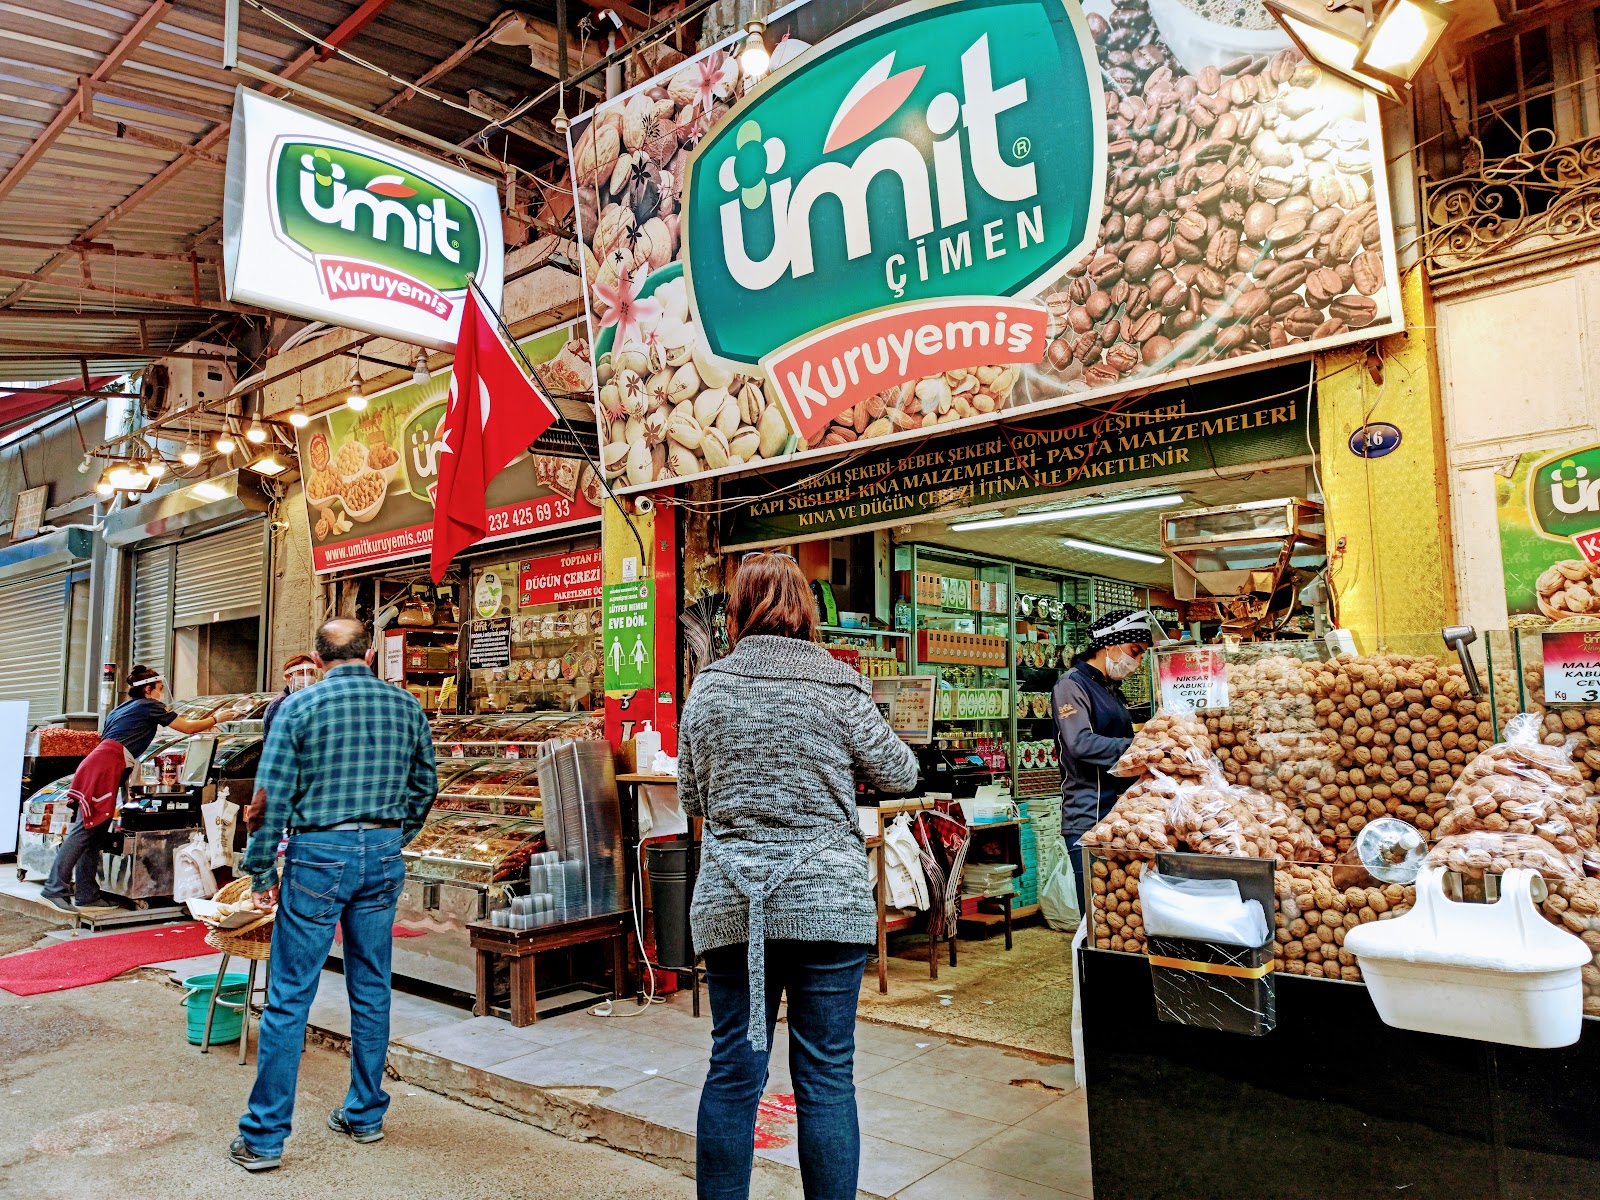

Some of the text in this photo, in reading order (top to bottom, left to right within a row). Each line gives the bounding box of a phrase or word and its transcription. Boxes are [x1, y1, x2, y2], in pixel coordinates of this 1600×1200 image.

[718, 32, 1039, 291] ümit
[299, 153, 460, 264] ümit
[885, 205, 1046, 298] ÇİMEN
[326, 264, 449, 316] Kuruyemiş
[787, 311, 1033, 421] Kuruyemiş
[750, 500, 784, 517] KAPI
[858, 478, 900, 498] KINA
[1047, 439, 1112, 465] PASTA
[1117, 399, 1297, 452] MALZEMELERİ
[898, 451, 945, 472] BEBEK
[1011, 425, 1089, 451] GONDOL
[1092, 399, 1187, 439] ÇEŞİTLERİ
[799, 510, 836, 527] KINA
[838, 504, 857, 520] VE
[860, 493, 915, 517] DÜĞÜN
[1033, 469, 1062, 488] İLE
[1066, 445, 1190, 482] PAKETLENİR
[488, 498, 570, 532] 232 425 69 33
[525, 566, 601, 591] DÜĞÜN ÇEREZİ
[560, 553, 593, 568] TOPTAN
[553, 588, 593, 601] PAKETLEME
[608, 617, 625, 630] EVE
[1186, 698, 1208, 708] 30
[1554, 690, 1567, 700] Kg
